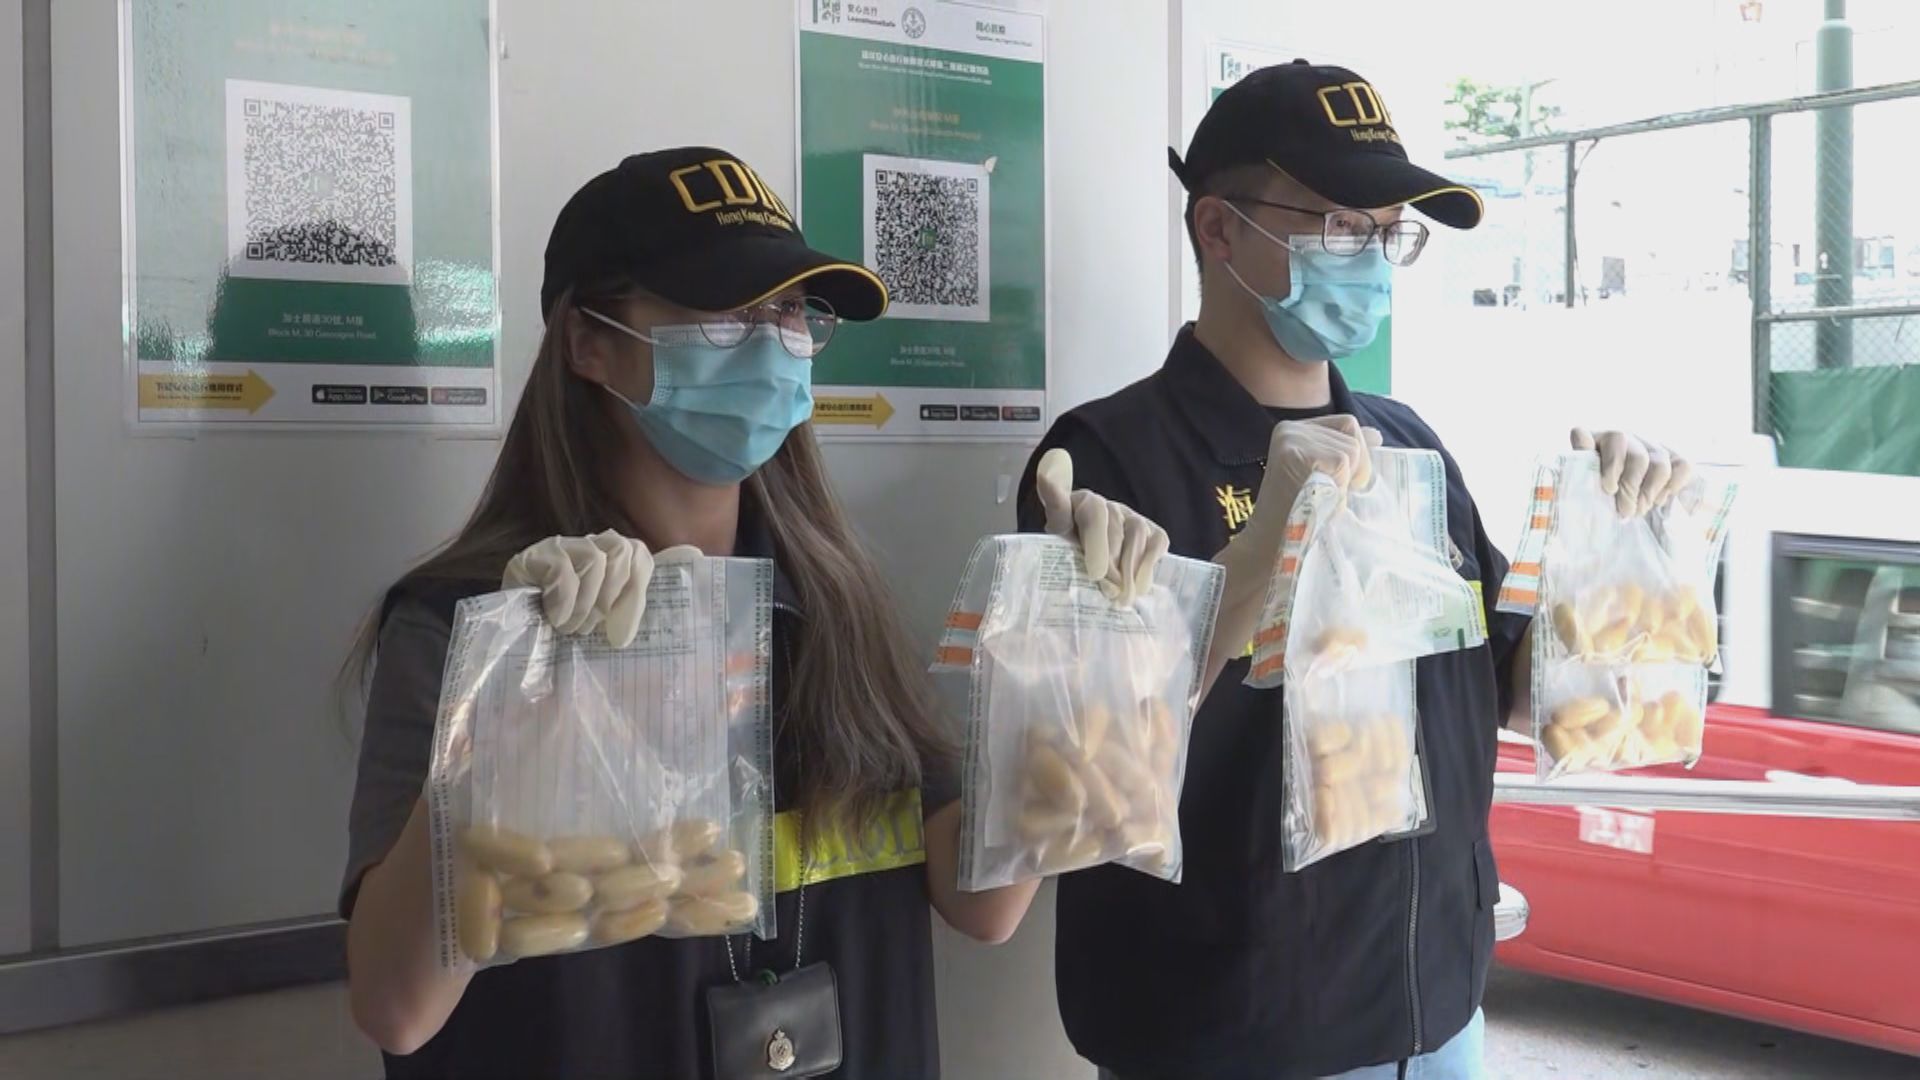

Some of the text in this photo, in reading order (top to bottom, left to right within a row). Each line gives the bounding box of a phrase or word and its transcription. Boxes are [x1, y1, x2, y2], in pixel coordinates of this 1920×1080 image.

[1316, 81, 1393, 128] CDI
[715, 210, 743, 226] Hong
[741, 208, 766, 226] Kong
[1215, 484, 1254, 532] 海
